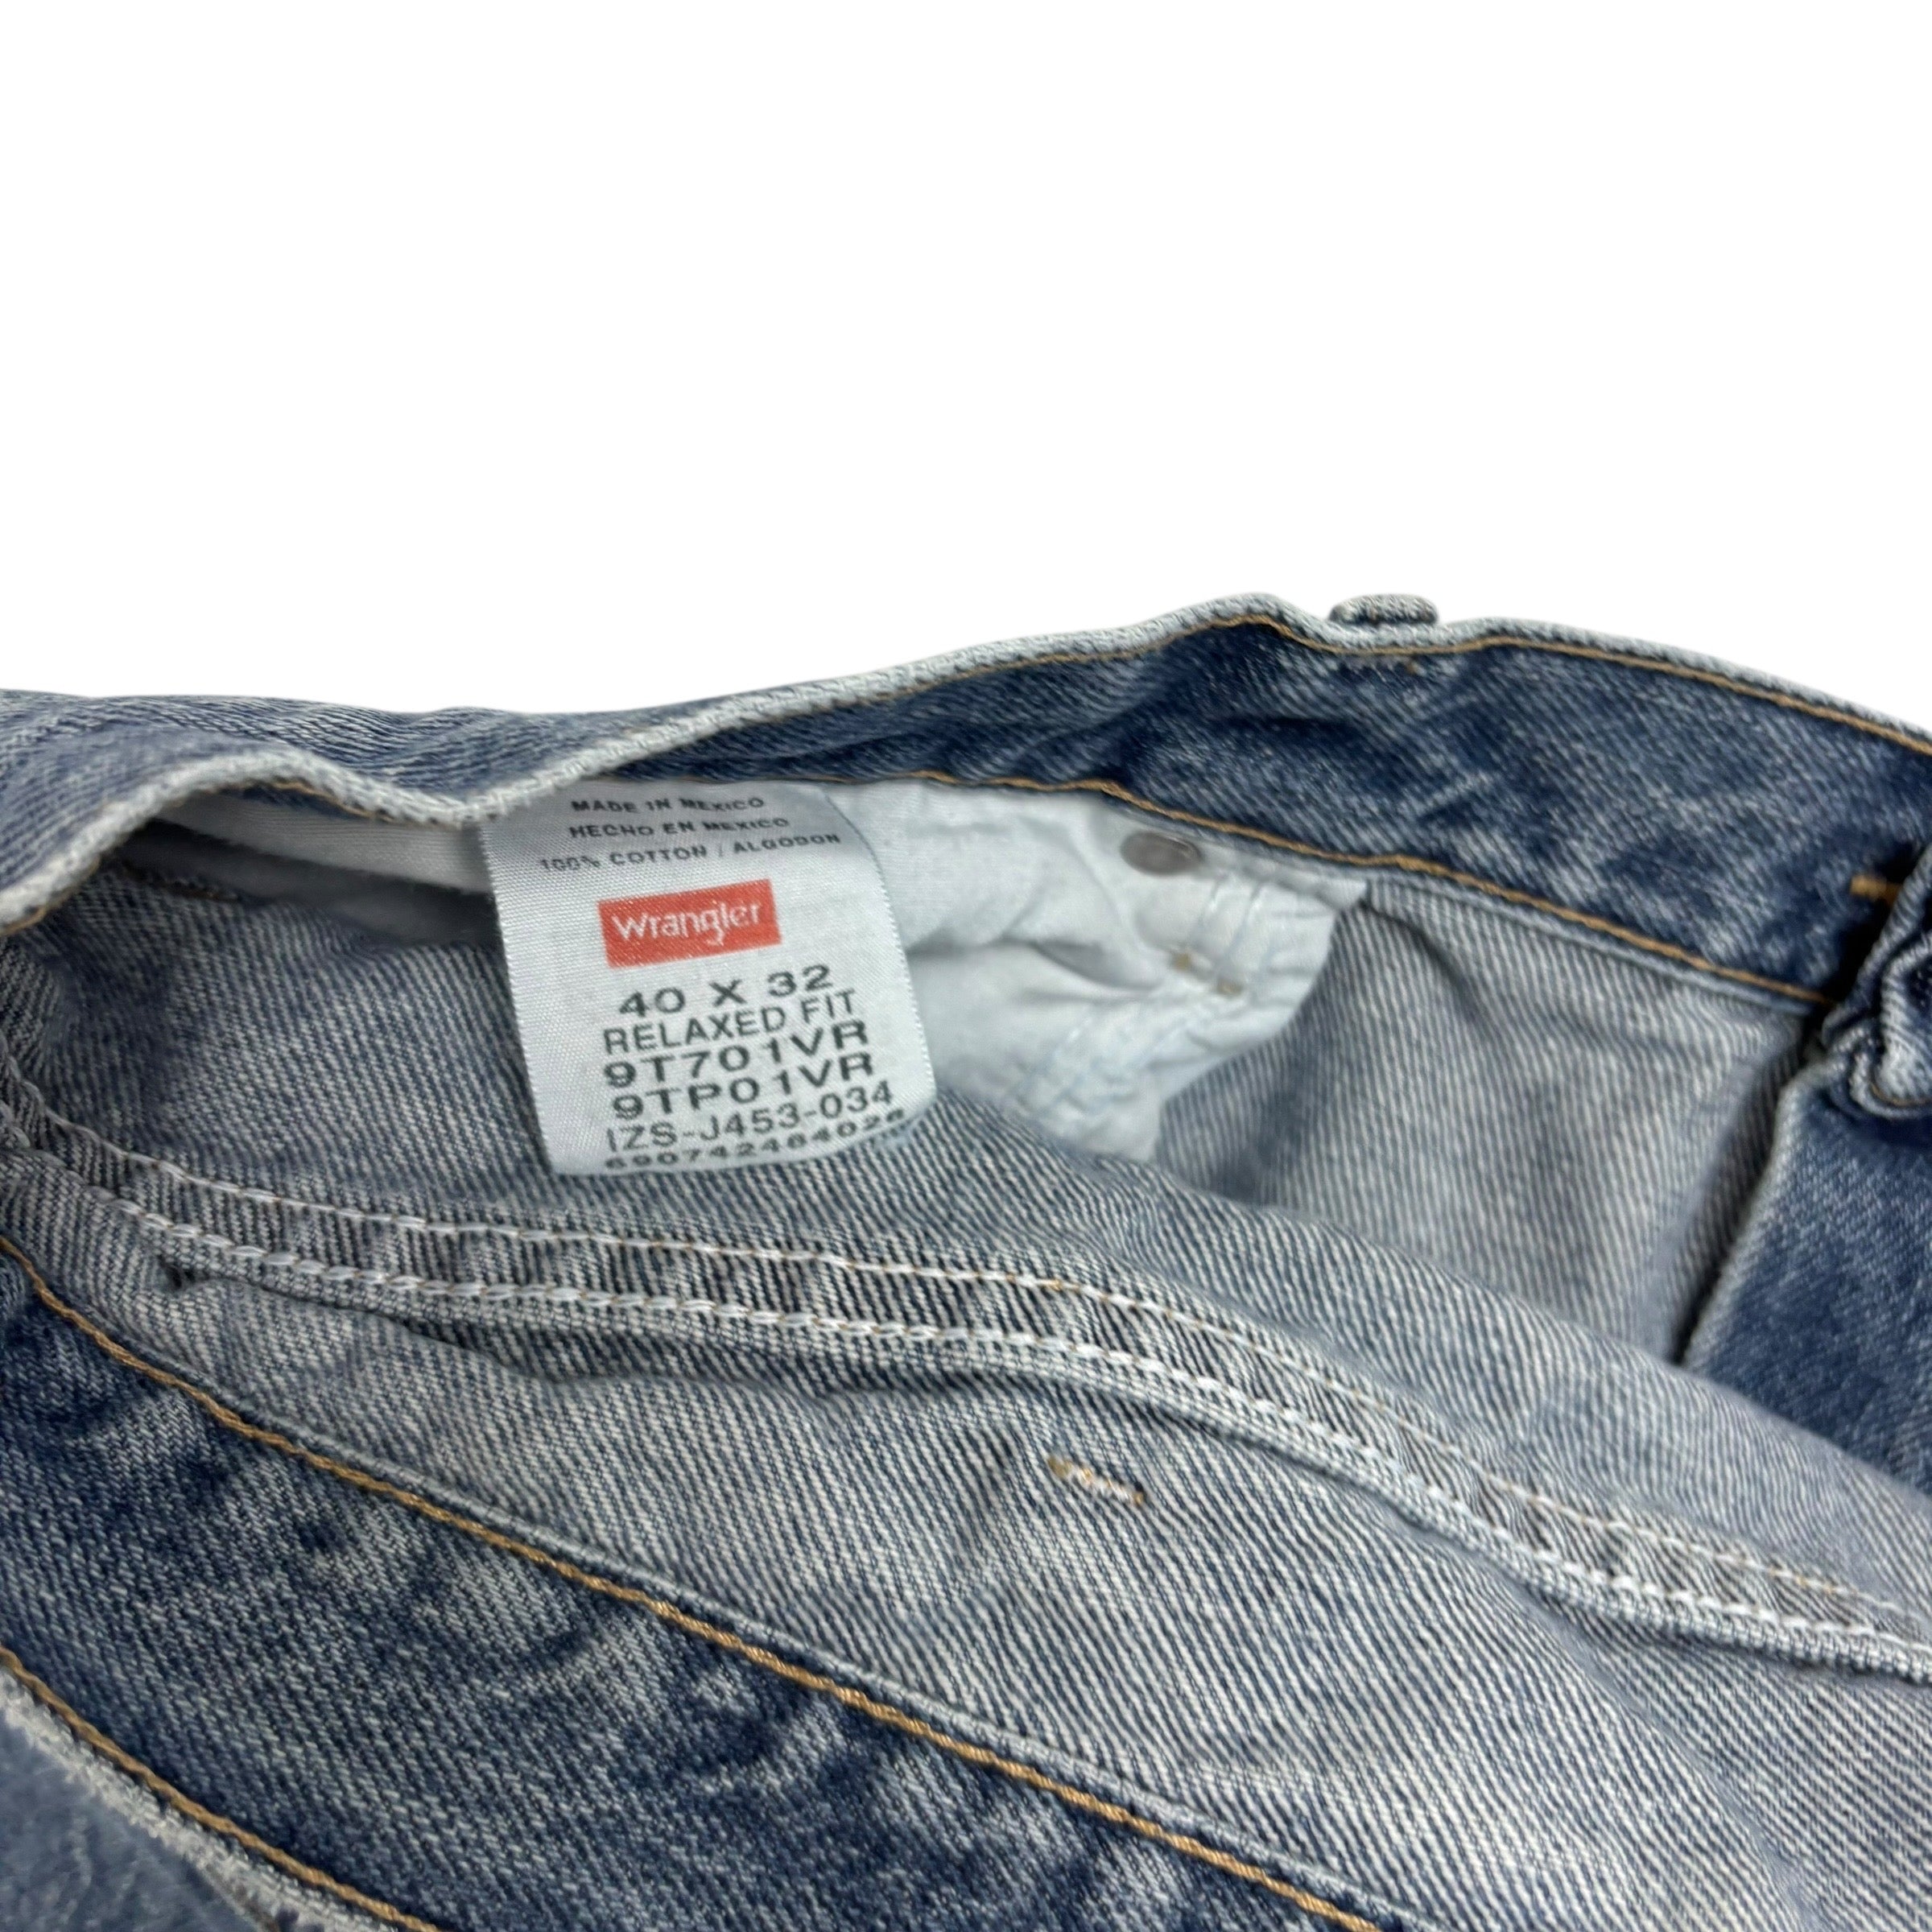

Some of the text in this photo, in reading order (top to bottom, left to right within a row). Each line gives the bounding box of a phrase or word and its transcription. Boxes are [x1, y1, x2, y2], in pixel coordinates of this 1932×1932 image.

[571, 797, 765, 813] MADE IN MEXICO
[569, 818, 790, 839] HECHO EN MEXICO
[540, 855, 601, 872] 100%
[609, 845, 707, 866] COTTON
[733, 834, 841, 853] ALGODON
[611, 902, 761, 947] Wrangler
[619, 964, 834, 1018] 40 X 32
[604, 988, 856, 1055] RELAXED FIT
[604, 1019, 869, 1088] 9T701VR
